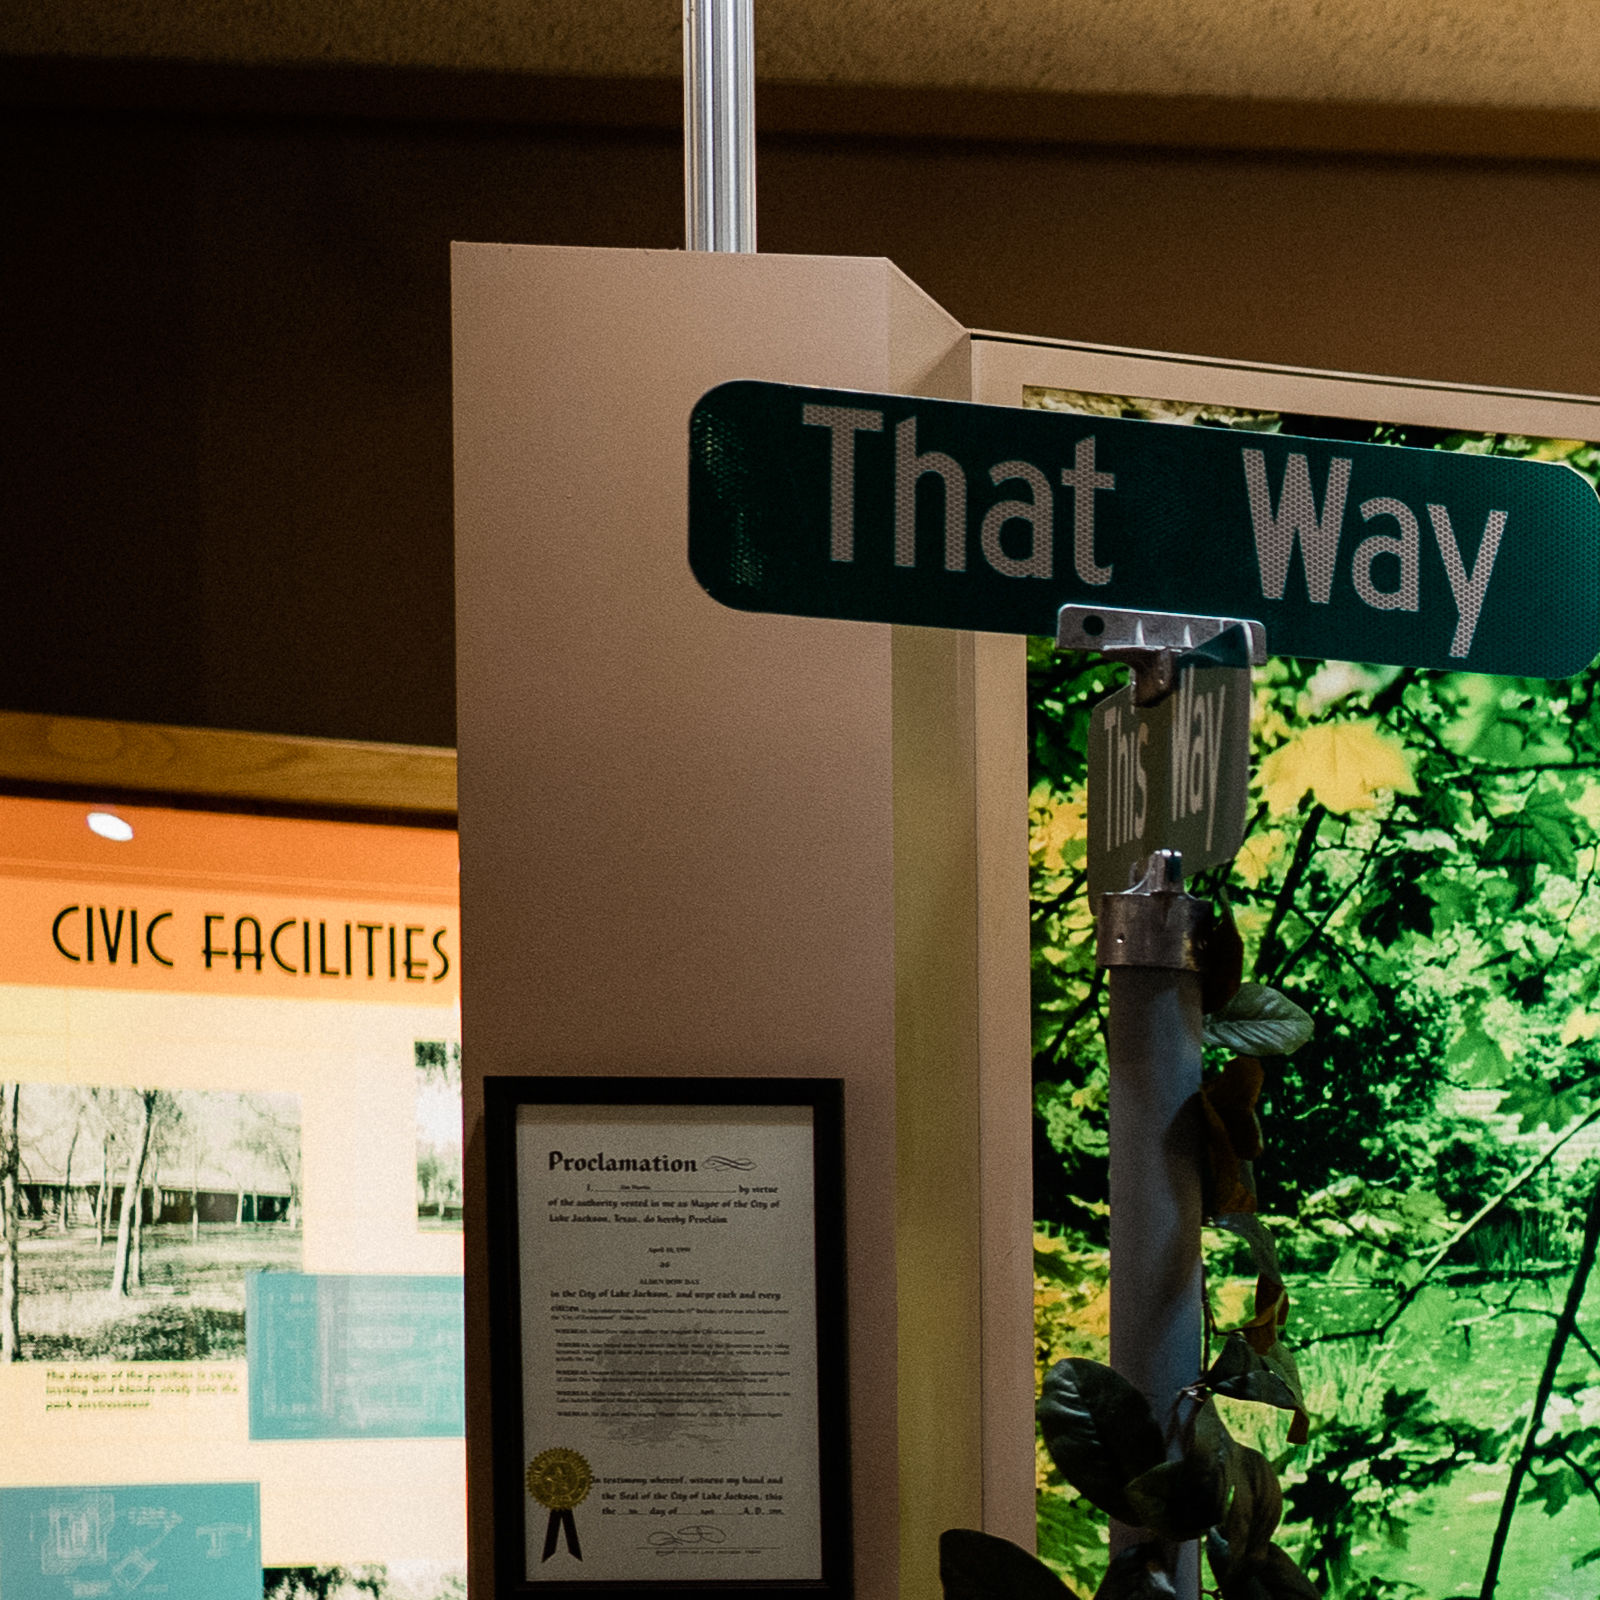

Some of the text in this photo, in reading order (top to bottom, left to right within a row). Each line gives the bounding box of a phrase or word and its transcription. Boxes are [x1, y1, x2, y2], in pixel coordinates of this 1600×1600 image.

[802, 404, 1509, 659] That Way
[1104, 664, 1226, 852] This Way
[52, 905, 450, 982] CIVIC FACILITIES
[549, 1150, 699, 1173] Proclamation
[738, 1184, 750, 1195] by
[548, 1198, 559, 1207] of
[560, 1198, 574, 1207] the
[576, 1199, 618, 1210] authority
[620, 1199, 648, 1208] vested
[690, 1200, 719, 1210] Mayor
[721, 1200, 731, 1208] of
[733, 1200, 748, 1208] the
[750, 1200, 768, 1211] City
[770, 1200, 780, 1208] of
[562, 1290, 577, 1298] the
[579, 1289, 596, 1300] City
[598, 1289, 609, 1297] of
[610, 1289, 630, 1298] Lake
[676, 1290, 693, 1298] and
[694, 1292, 715, 1300] urge
[716, 1290, 737, 1298] each
[739, 1290, 756, 1298] and
[758, 1292, 781, 1301] every
[602, 1507, 616, 1515] the
[649, 1506, 665, 1517] day
[667, 1507, 678, 1515] of
